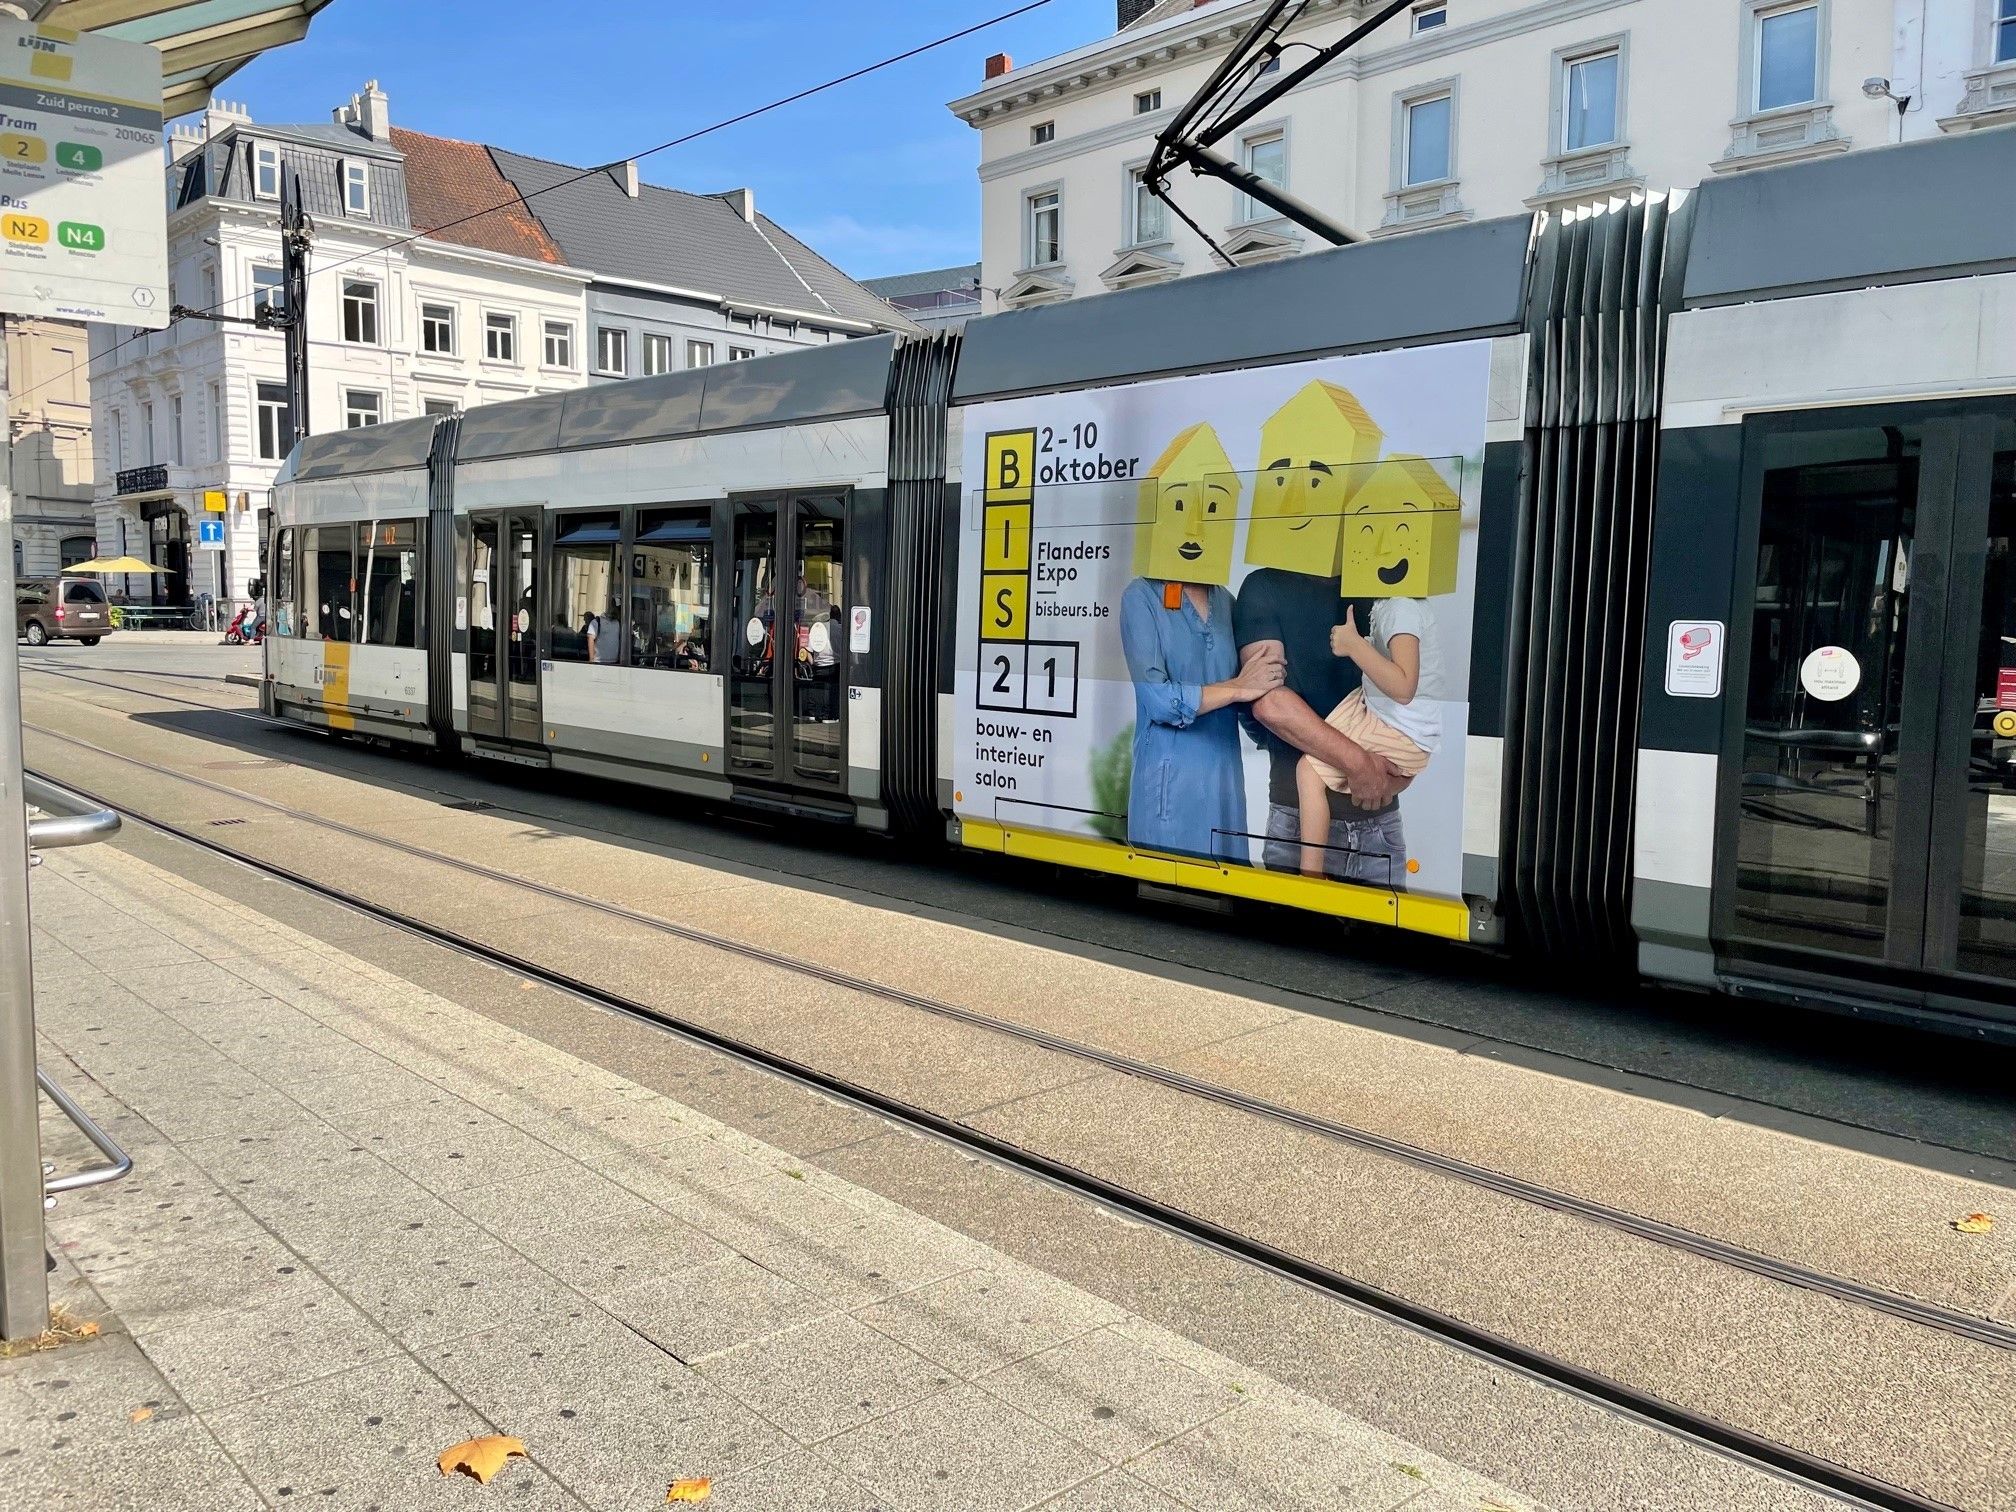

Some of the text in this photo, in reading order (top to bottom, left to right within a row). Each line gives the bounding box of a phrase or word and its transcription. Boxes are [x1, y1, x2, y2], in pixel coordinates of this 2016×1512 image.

[36, 94, 119, 119] Zuid perron 2
[0, 113, 37, 131] Tram
[115, 128, 156, 145] 201065
[17, 141, 29, 157] 2
[72, 150, 86, 166] 4
[1, 195, 28, 210] Bus
[12, 221, 39, 239] N2
[67, 228, 96, 246] N4
[141, 293, 146, 302] 1
[56, 307, 105, 317] www.delijn.be
[1039, 452, 1139, 485] oktober
[1038, 540, 1110, 560] Flanders
[1037, 562, 1078, 586] Expo
[1035, 601, 1109, 618] bisbeurs.be
[976, 717, 1052, 743] bouw- en
[975, 742, 1044, 768] interieur
[975, 769, 1017, 791] salon
